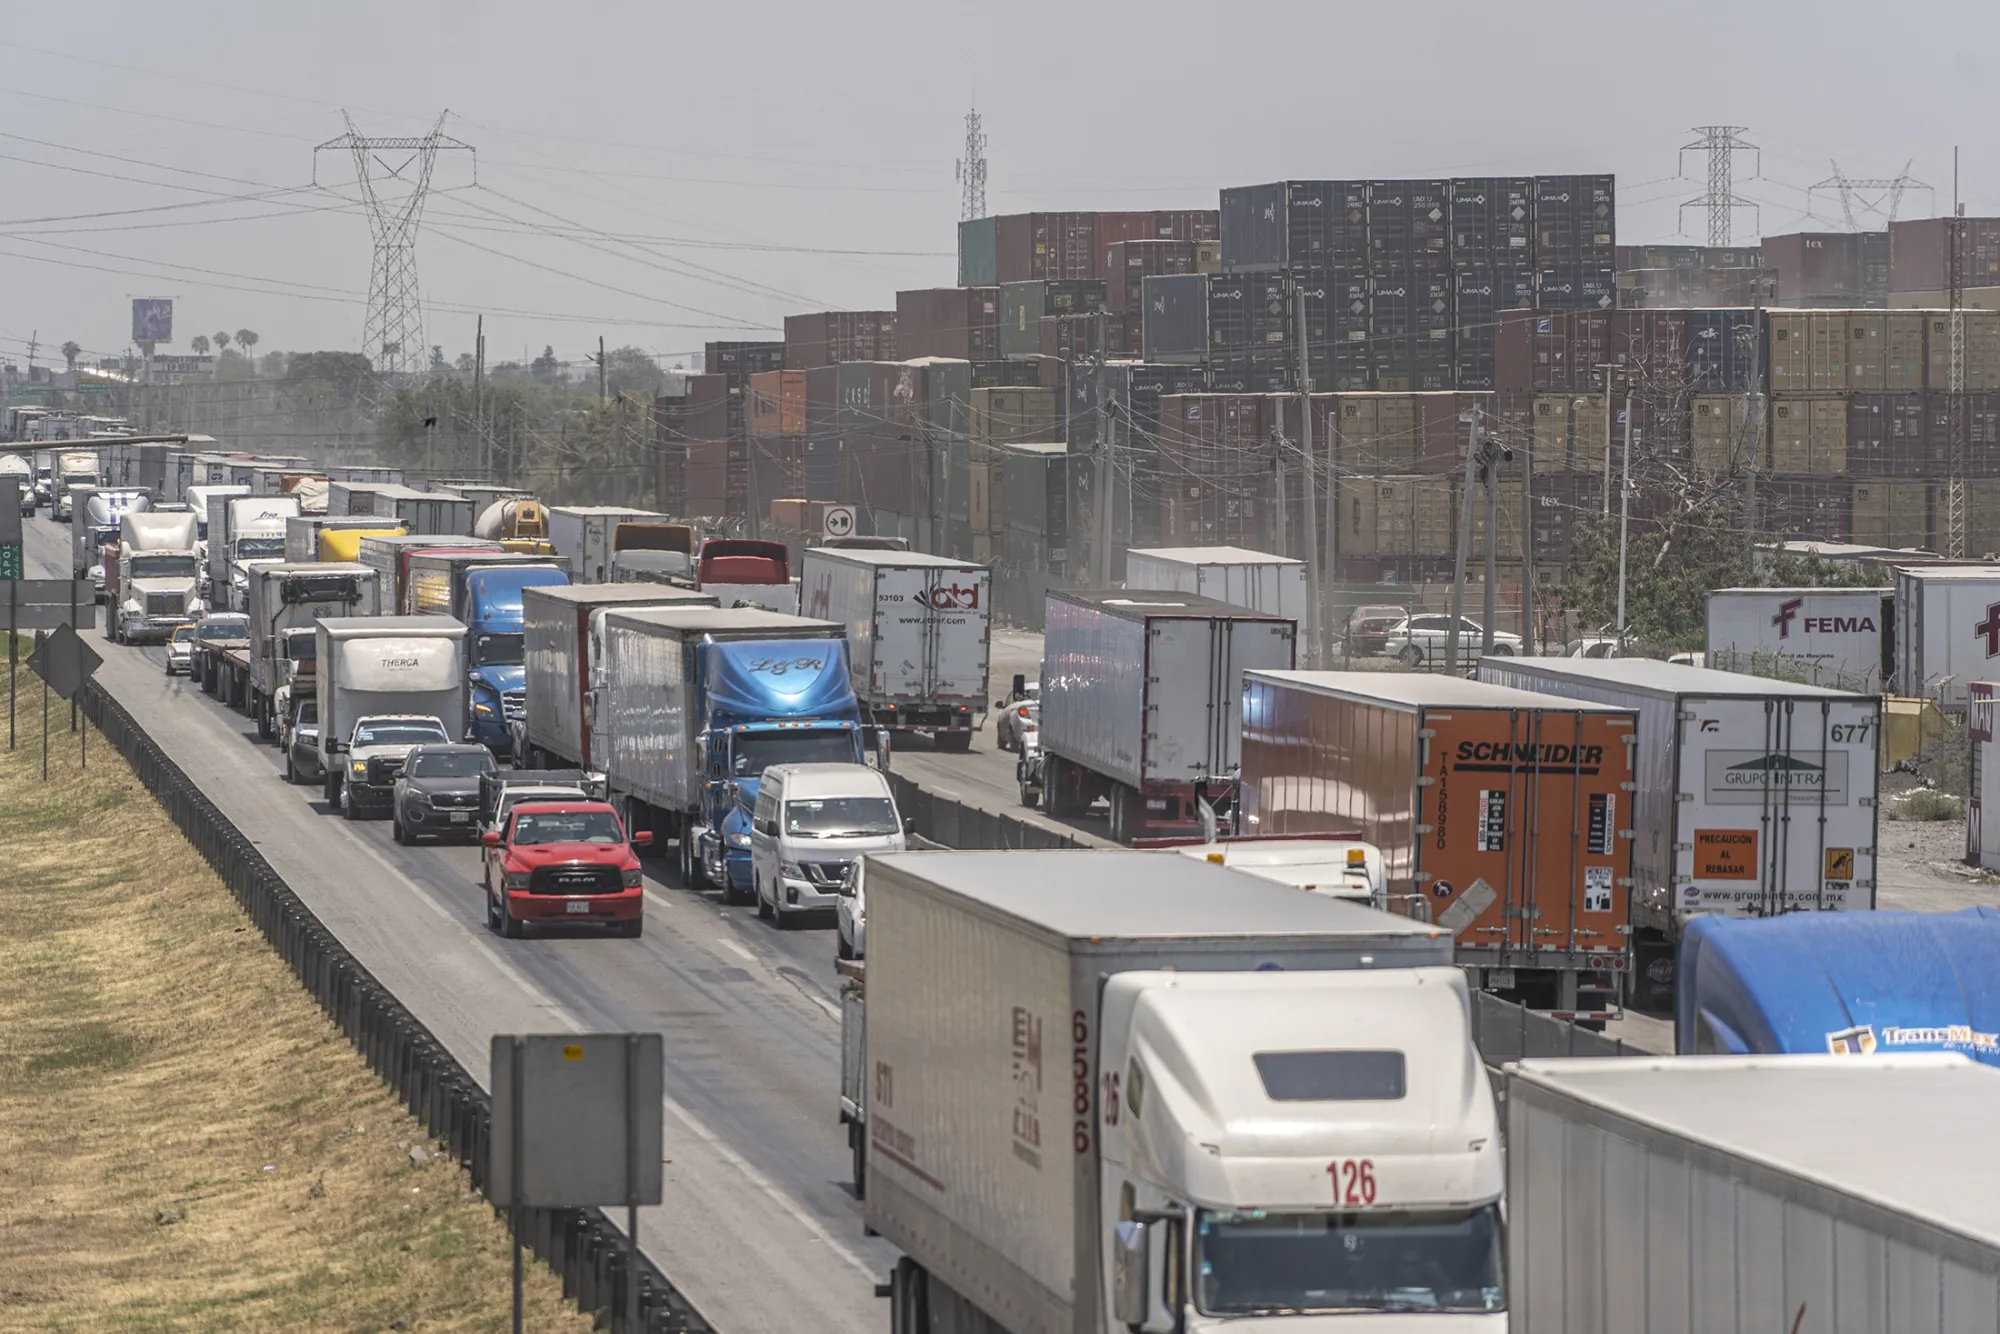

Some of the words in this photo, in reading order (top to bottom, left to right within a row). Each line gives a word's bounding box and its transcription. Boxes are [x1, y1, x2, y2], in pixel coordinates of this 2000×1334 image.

[1806, 239, 1823, 248] tex
[1541, 496, 1559, 506] tex
[879, 594, 904, 602] 53103
[1804, 617, 1876, 633] FEMA
[381, 659, 419, 668] THERCA
[1831, 724, 1870, 743] 677
[1456, 741, 1603, 764] SCHNEIDER
[1725, 772, 1769, 784] GRUPO
[1720, 850, 1731, 859] AL
[1706, 865, 1745, 874] REBASAR
[1326, 1159, 1376, 1205] 126
